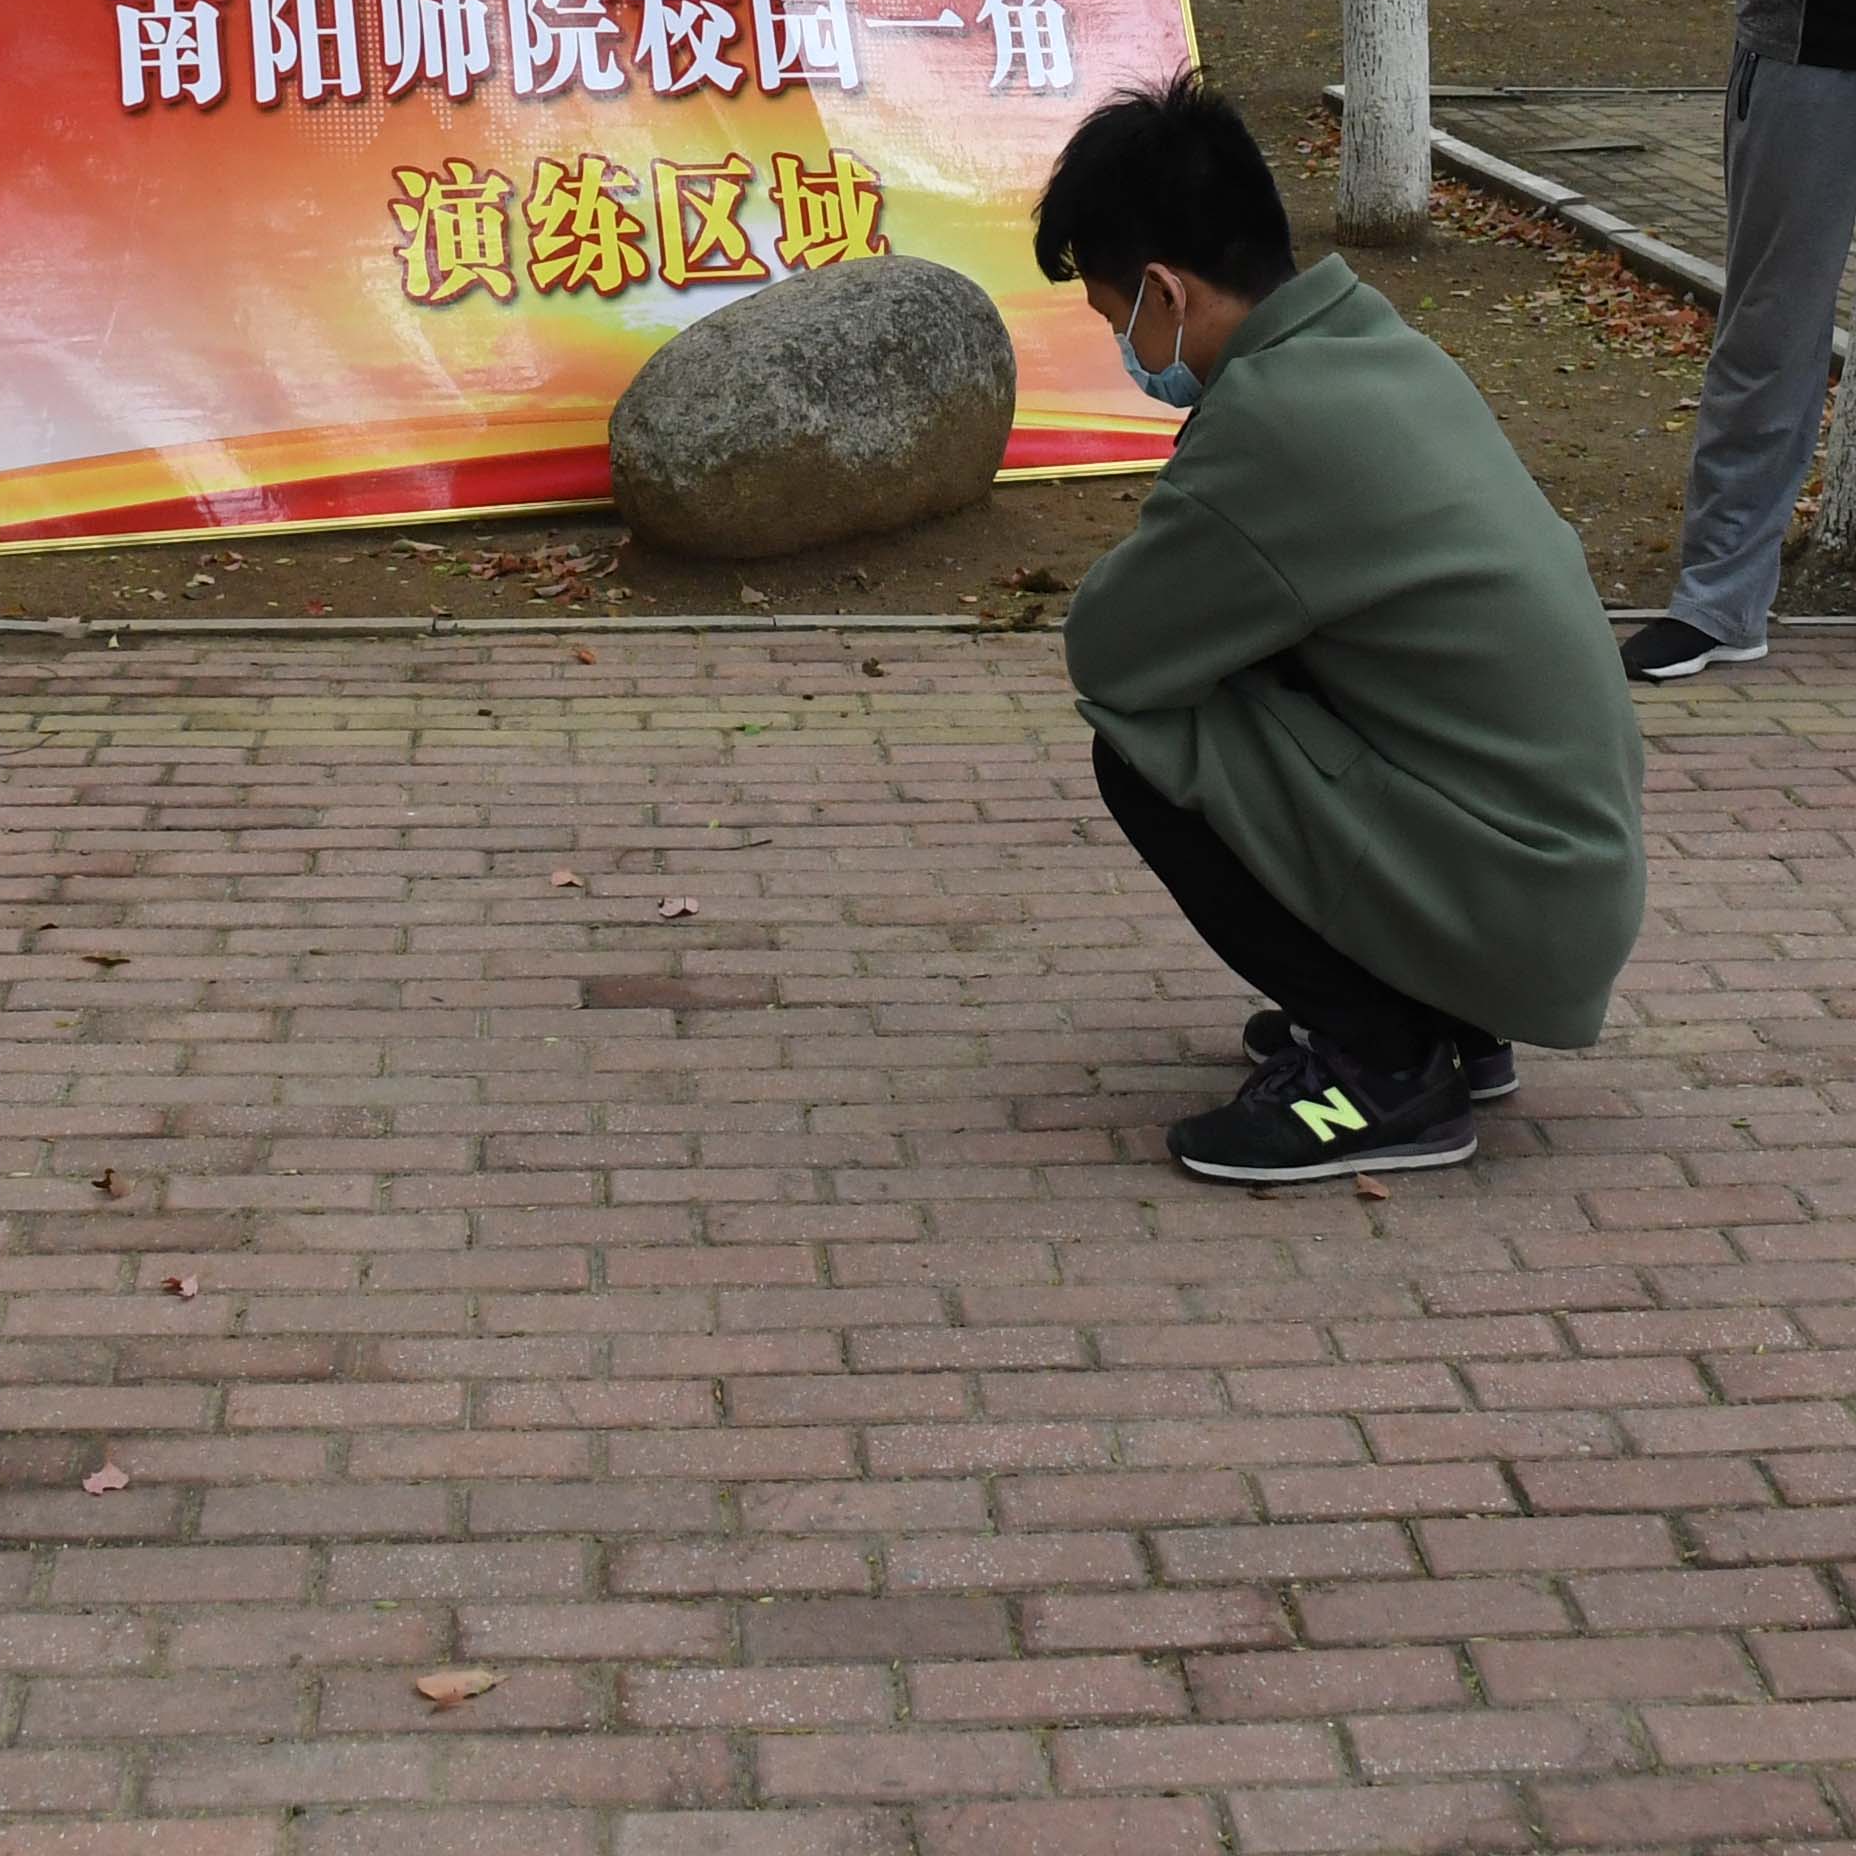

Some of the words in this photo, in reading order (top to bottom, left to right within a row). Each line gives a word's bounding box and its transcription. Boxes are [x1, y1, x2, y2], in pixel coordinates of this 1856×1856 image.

[390, 151, 888, 303] 演练区域
[1290, 1086, 1369, 1143] N
